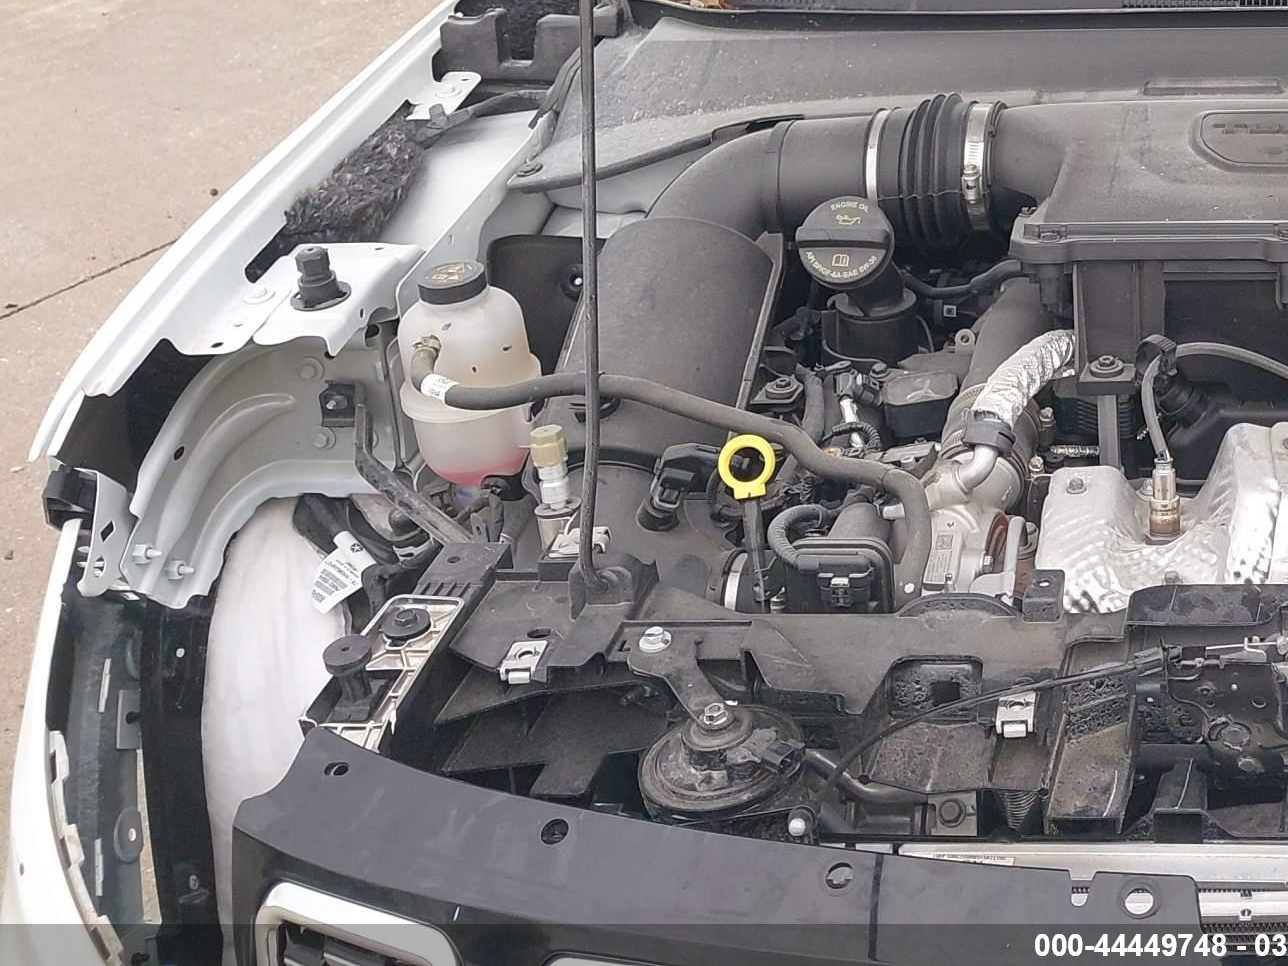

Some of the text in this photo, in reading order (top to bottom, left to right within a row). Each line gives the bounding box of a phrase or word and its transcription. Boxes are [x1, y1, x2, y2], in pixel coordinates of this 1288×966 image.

[830, 201, 870, 213] ENGINE OIL
[806, 251, 817, 264] API
